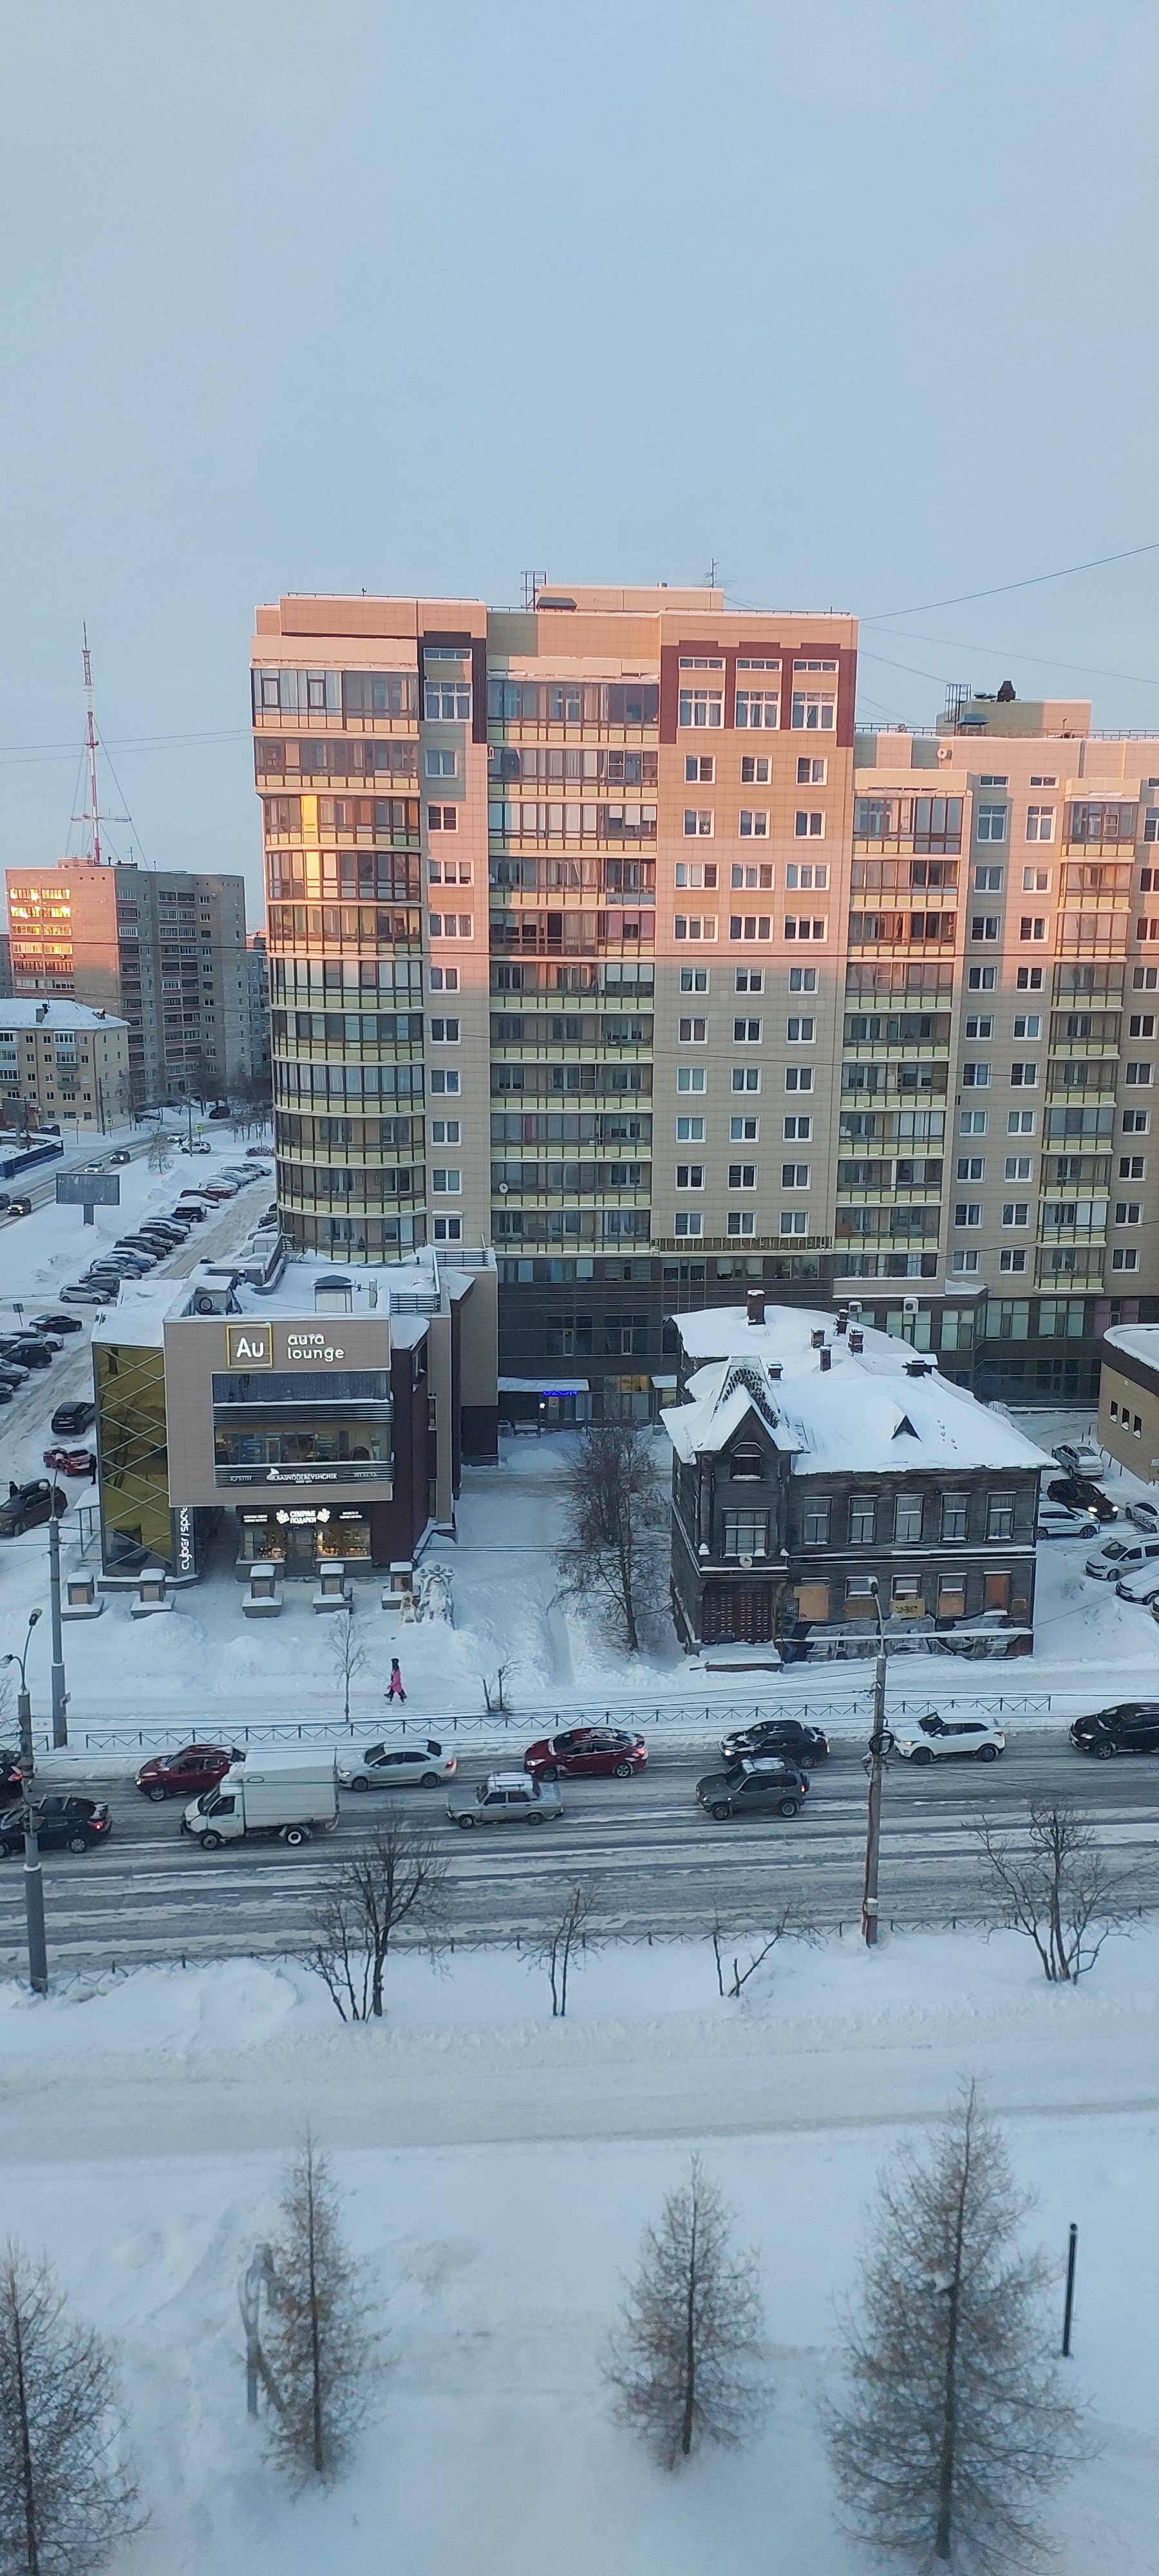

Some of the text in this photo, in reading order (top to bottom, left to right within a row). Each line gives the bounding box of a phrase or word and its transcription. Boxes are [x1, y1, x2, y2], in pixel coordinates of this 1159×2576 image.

[288, 1334, 325, 1345] aura
[236, 1338, 264, 1358] Au
[288, 1347, 344, 1362] lounge
